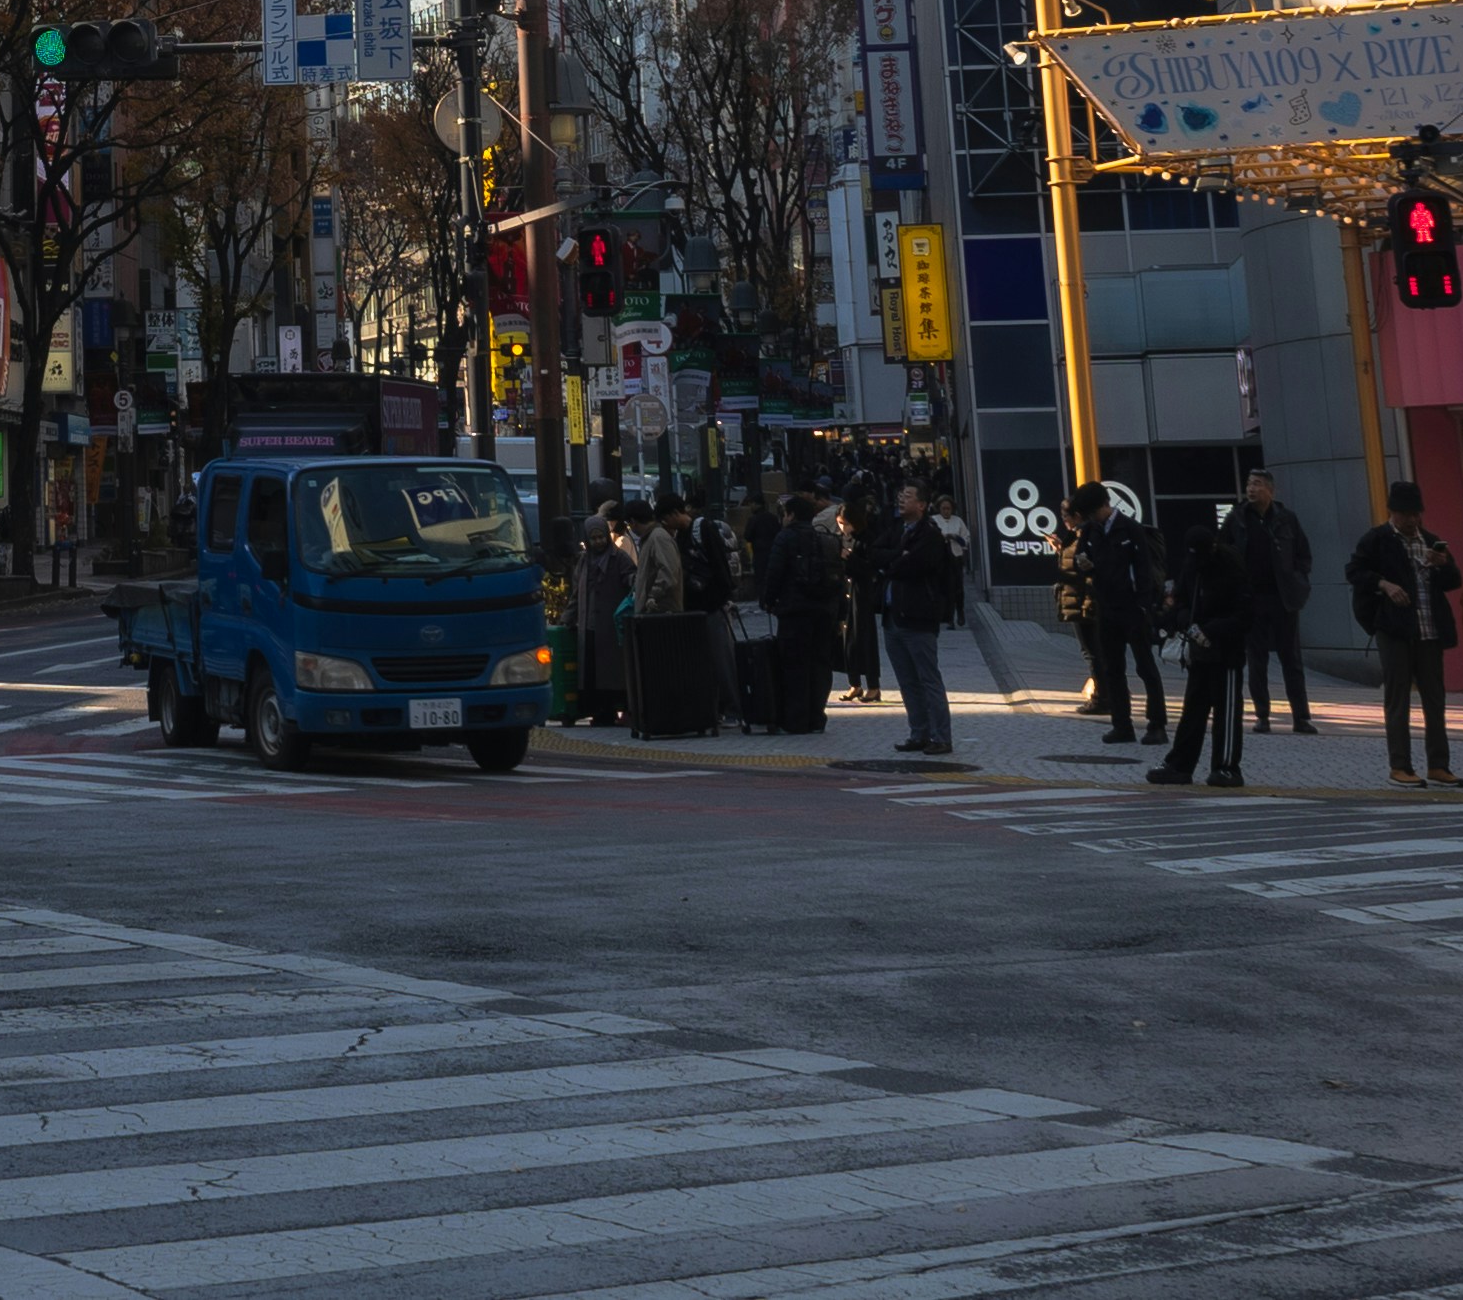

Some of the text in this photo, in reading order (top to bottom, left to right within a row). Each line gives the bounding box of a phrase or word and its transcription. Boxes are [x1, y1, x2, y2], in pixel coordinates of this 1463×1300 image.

[363, 31, 374, 58] shita
[301, 66, 353, 82] 時差式
[1102, 45, 1323, 101] SHIBUYA109
[1362, 33, 1461, 80] RIIZE
[878, 54, 904, 155] まねきねこ
[885, 156, 908, 172] 4F
[889, 291, 900, 325] Royal
[917, 259, 940, 341] 珈琲茶館集
[147, 312, 175, 327] 整体
[911, 380, 925, 389] 2F
[118, 393, 127, 407] 5
[238, 435, 335, 448] SUPER BEAVER
[422, 710, 460, 727] 10-80
